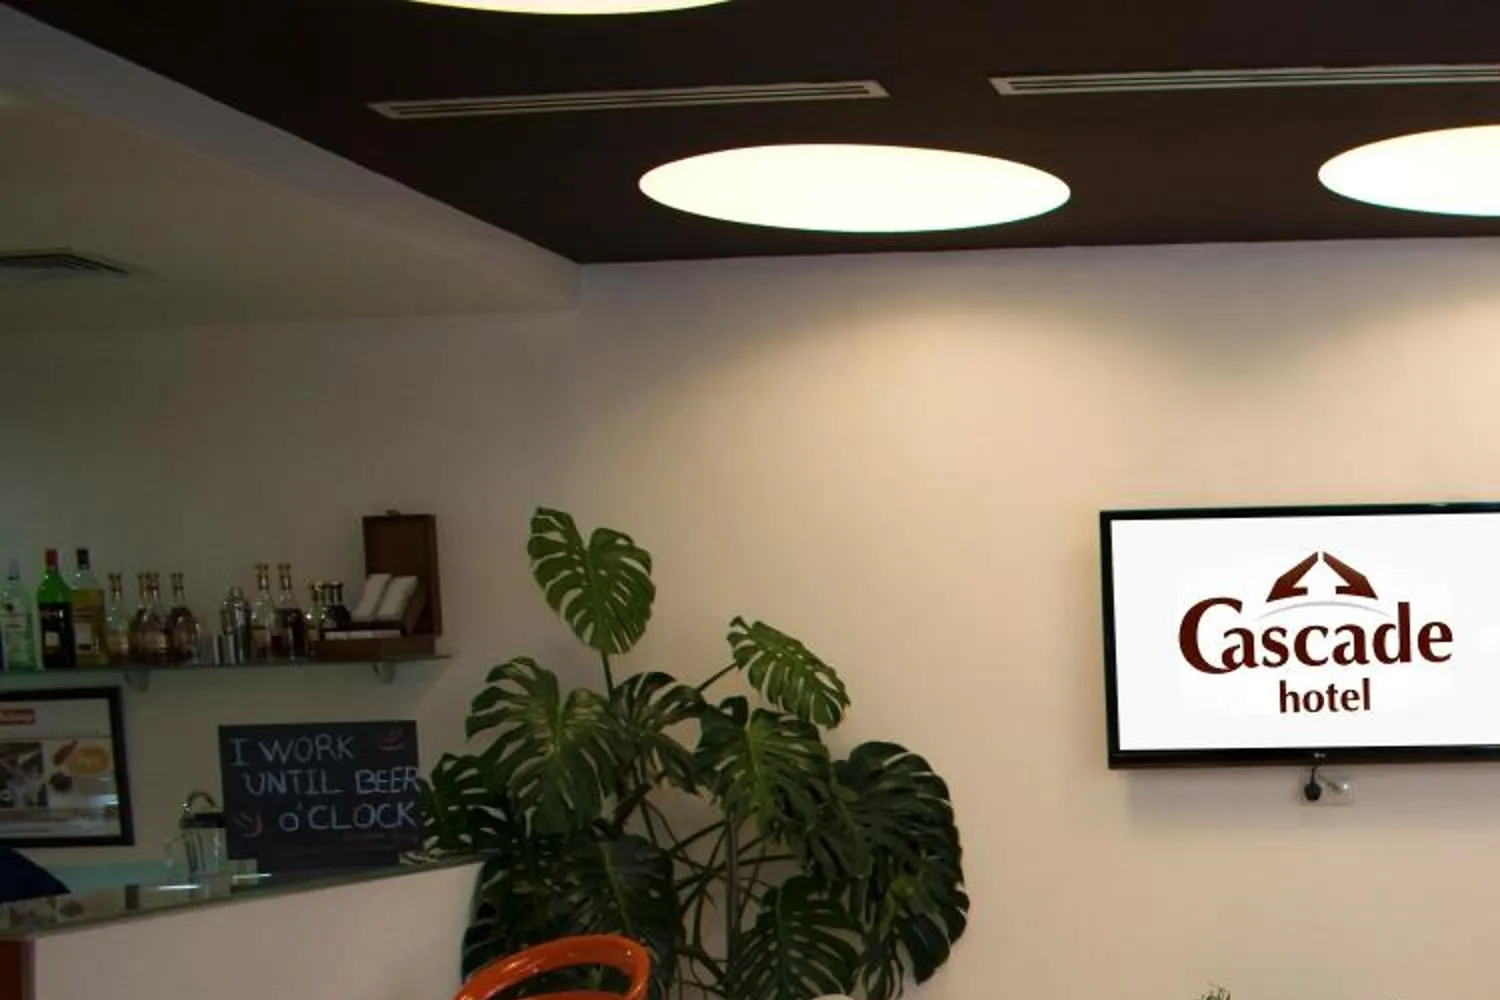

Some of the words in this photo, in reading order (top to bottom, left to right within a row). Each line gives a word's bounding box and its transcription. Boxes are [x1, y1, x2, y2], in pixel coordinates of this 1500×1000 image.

[1179, 597, 1454, 674] Cascade
[1280, 677, 1371, 713] hotel
[229, 737, 250, 767] I
[257, 733, 355, 765] WORK
[241, 767, 346, 797] UNTIL
[353, 765, 421, 795] BEER
